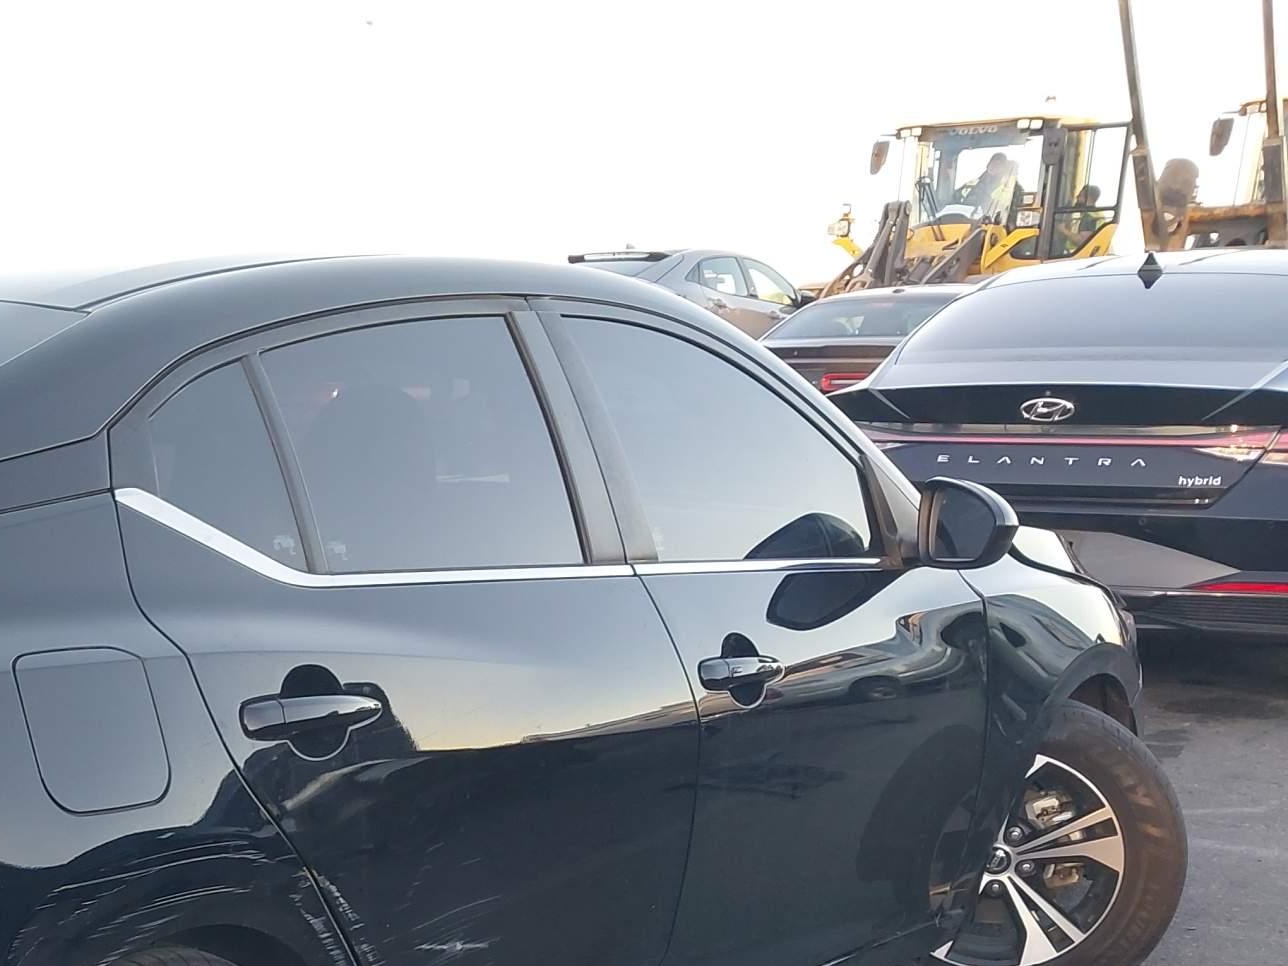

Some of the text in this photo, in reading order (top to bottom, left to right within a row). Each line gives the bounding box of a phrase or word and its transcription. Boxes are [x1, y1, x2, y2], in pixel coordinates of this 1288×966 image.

[949, 125, 999, 136] VOLVO
[936, 454, 1146, 468] ELANTRA
[1178, 475, 1222, 488] hybrid
